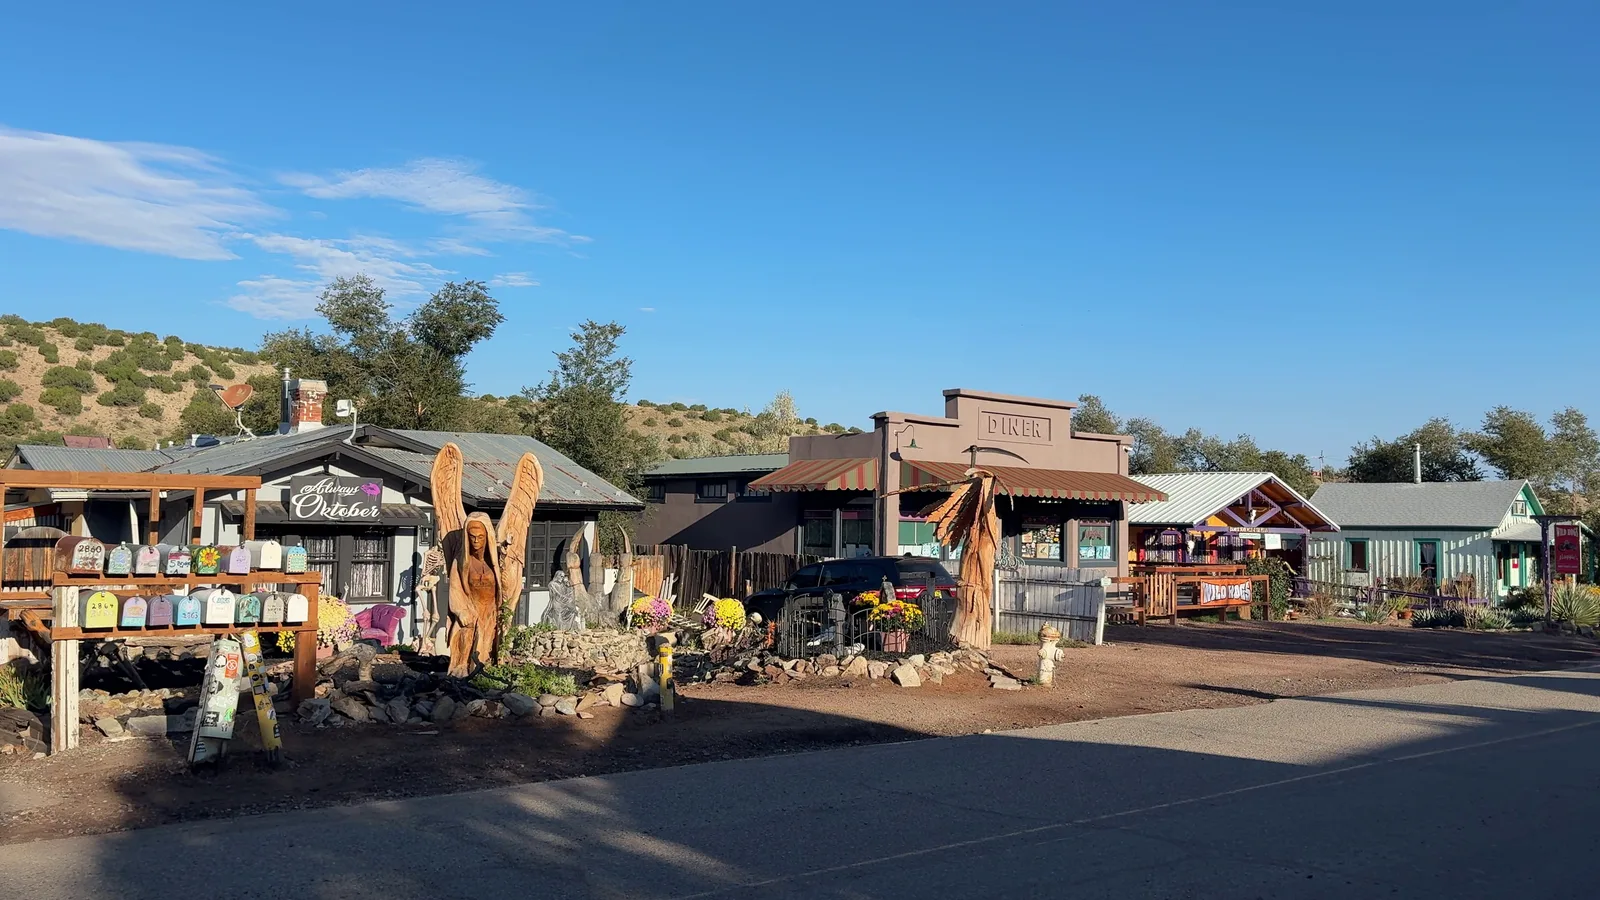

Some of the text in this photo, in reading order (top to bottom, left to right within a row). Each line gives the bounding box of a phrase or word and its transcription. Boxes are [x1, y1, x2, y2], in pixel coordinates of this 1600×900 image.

[988, 415, 1041, 438] DINER
[300, 477, 360, 497] Always
[291, 494, 380, 520] Oktober
[78, 544, 102, 554] 2860
[1202, 579, 1252, 604] WILD HOGS
